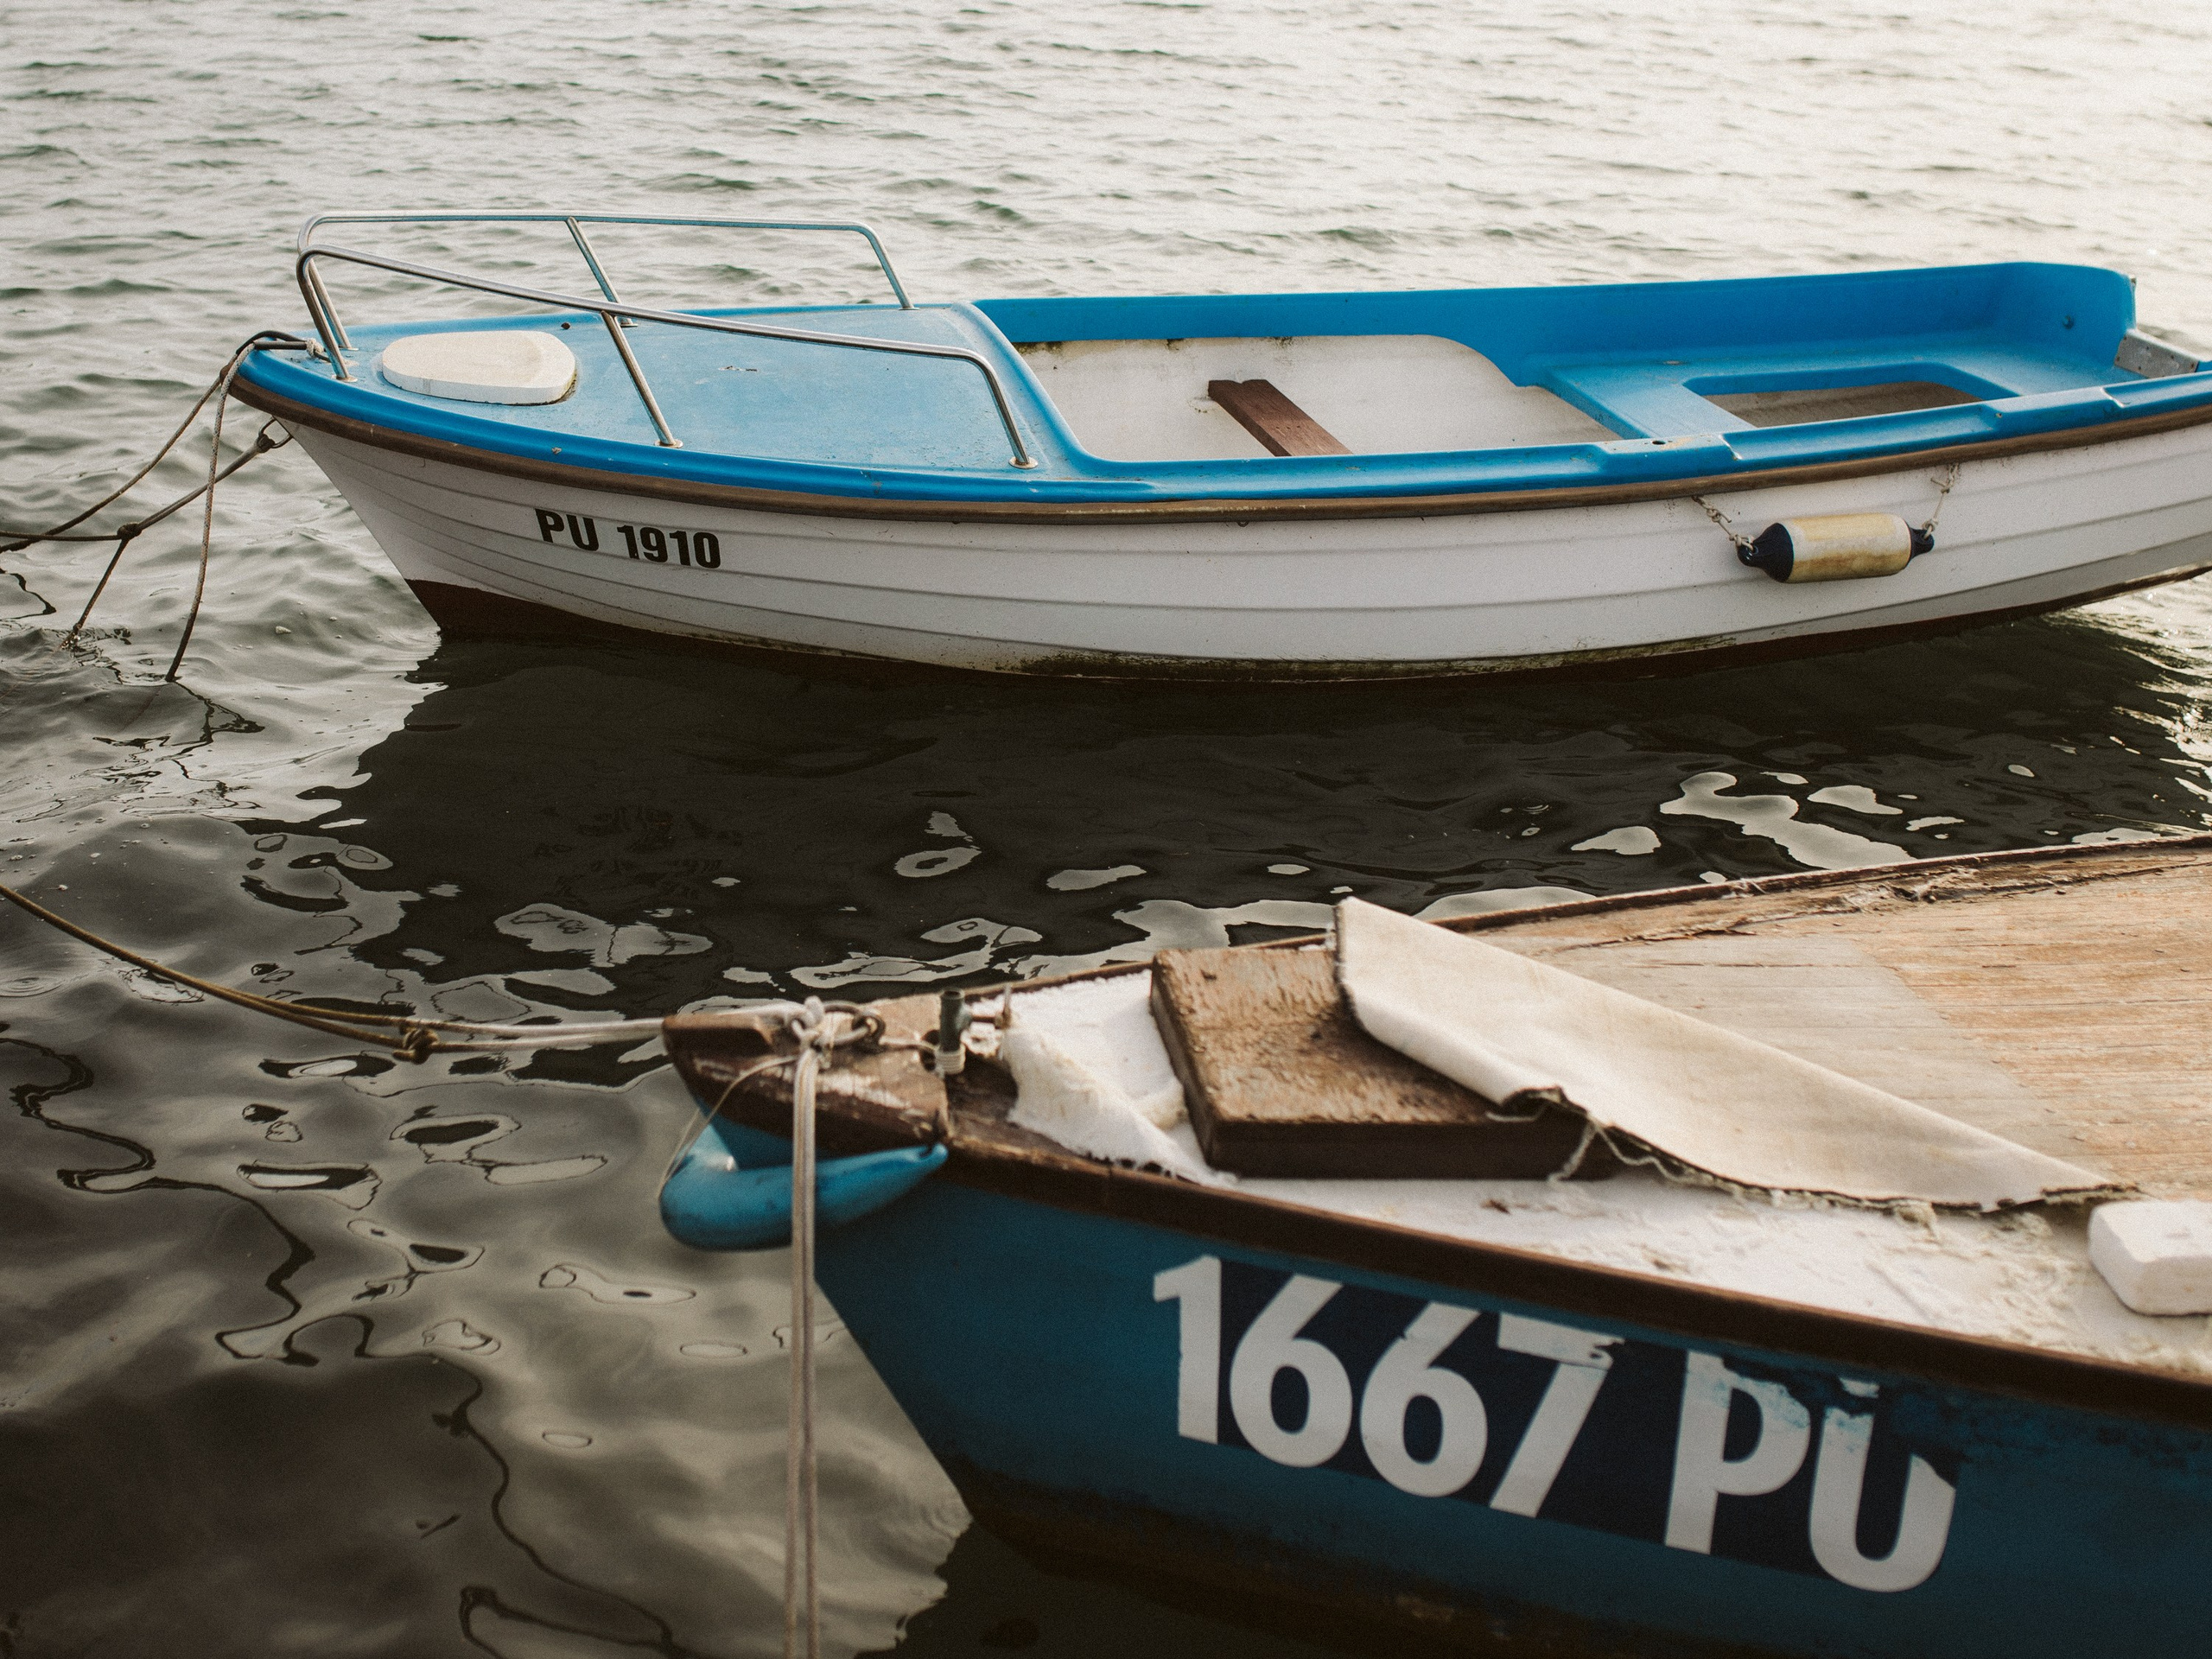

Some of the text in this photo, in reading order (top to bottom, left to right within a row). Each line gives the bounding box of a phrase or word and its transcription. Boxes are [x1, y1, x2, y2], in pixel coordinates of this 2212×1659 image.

[534, 508, 721, 569] PU 1910
[1153, 1255, 1958, 1592] 1667 PU
